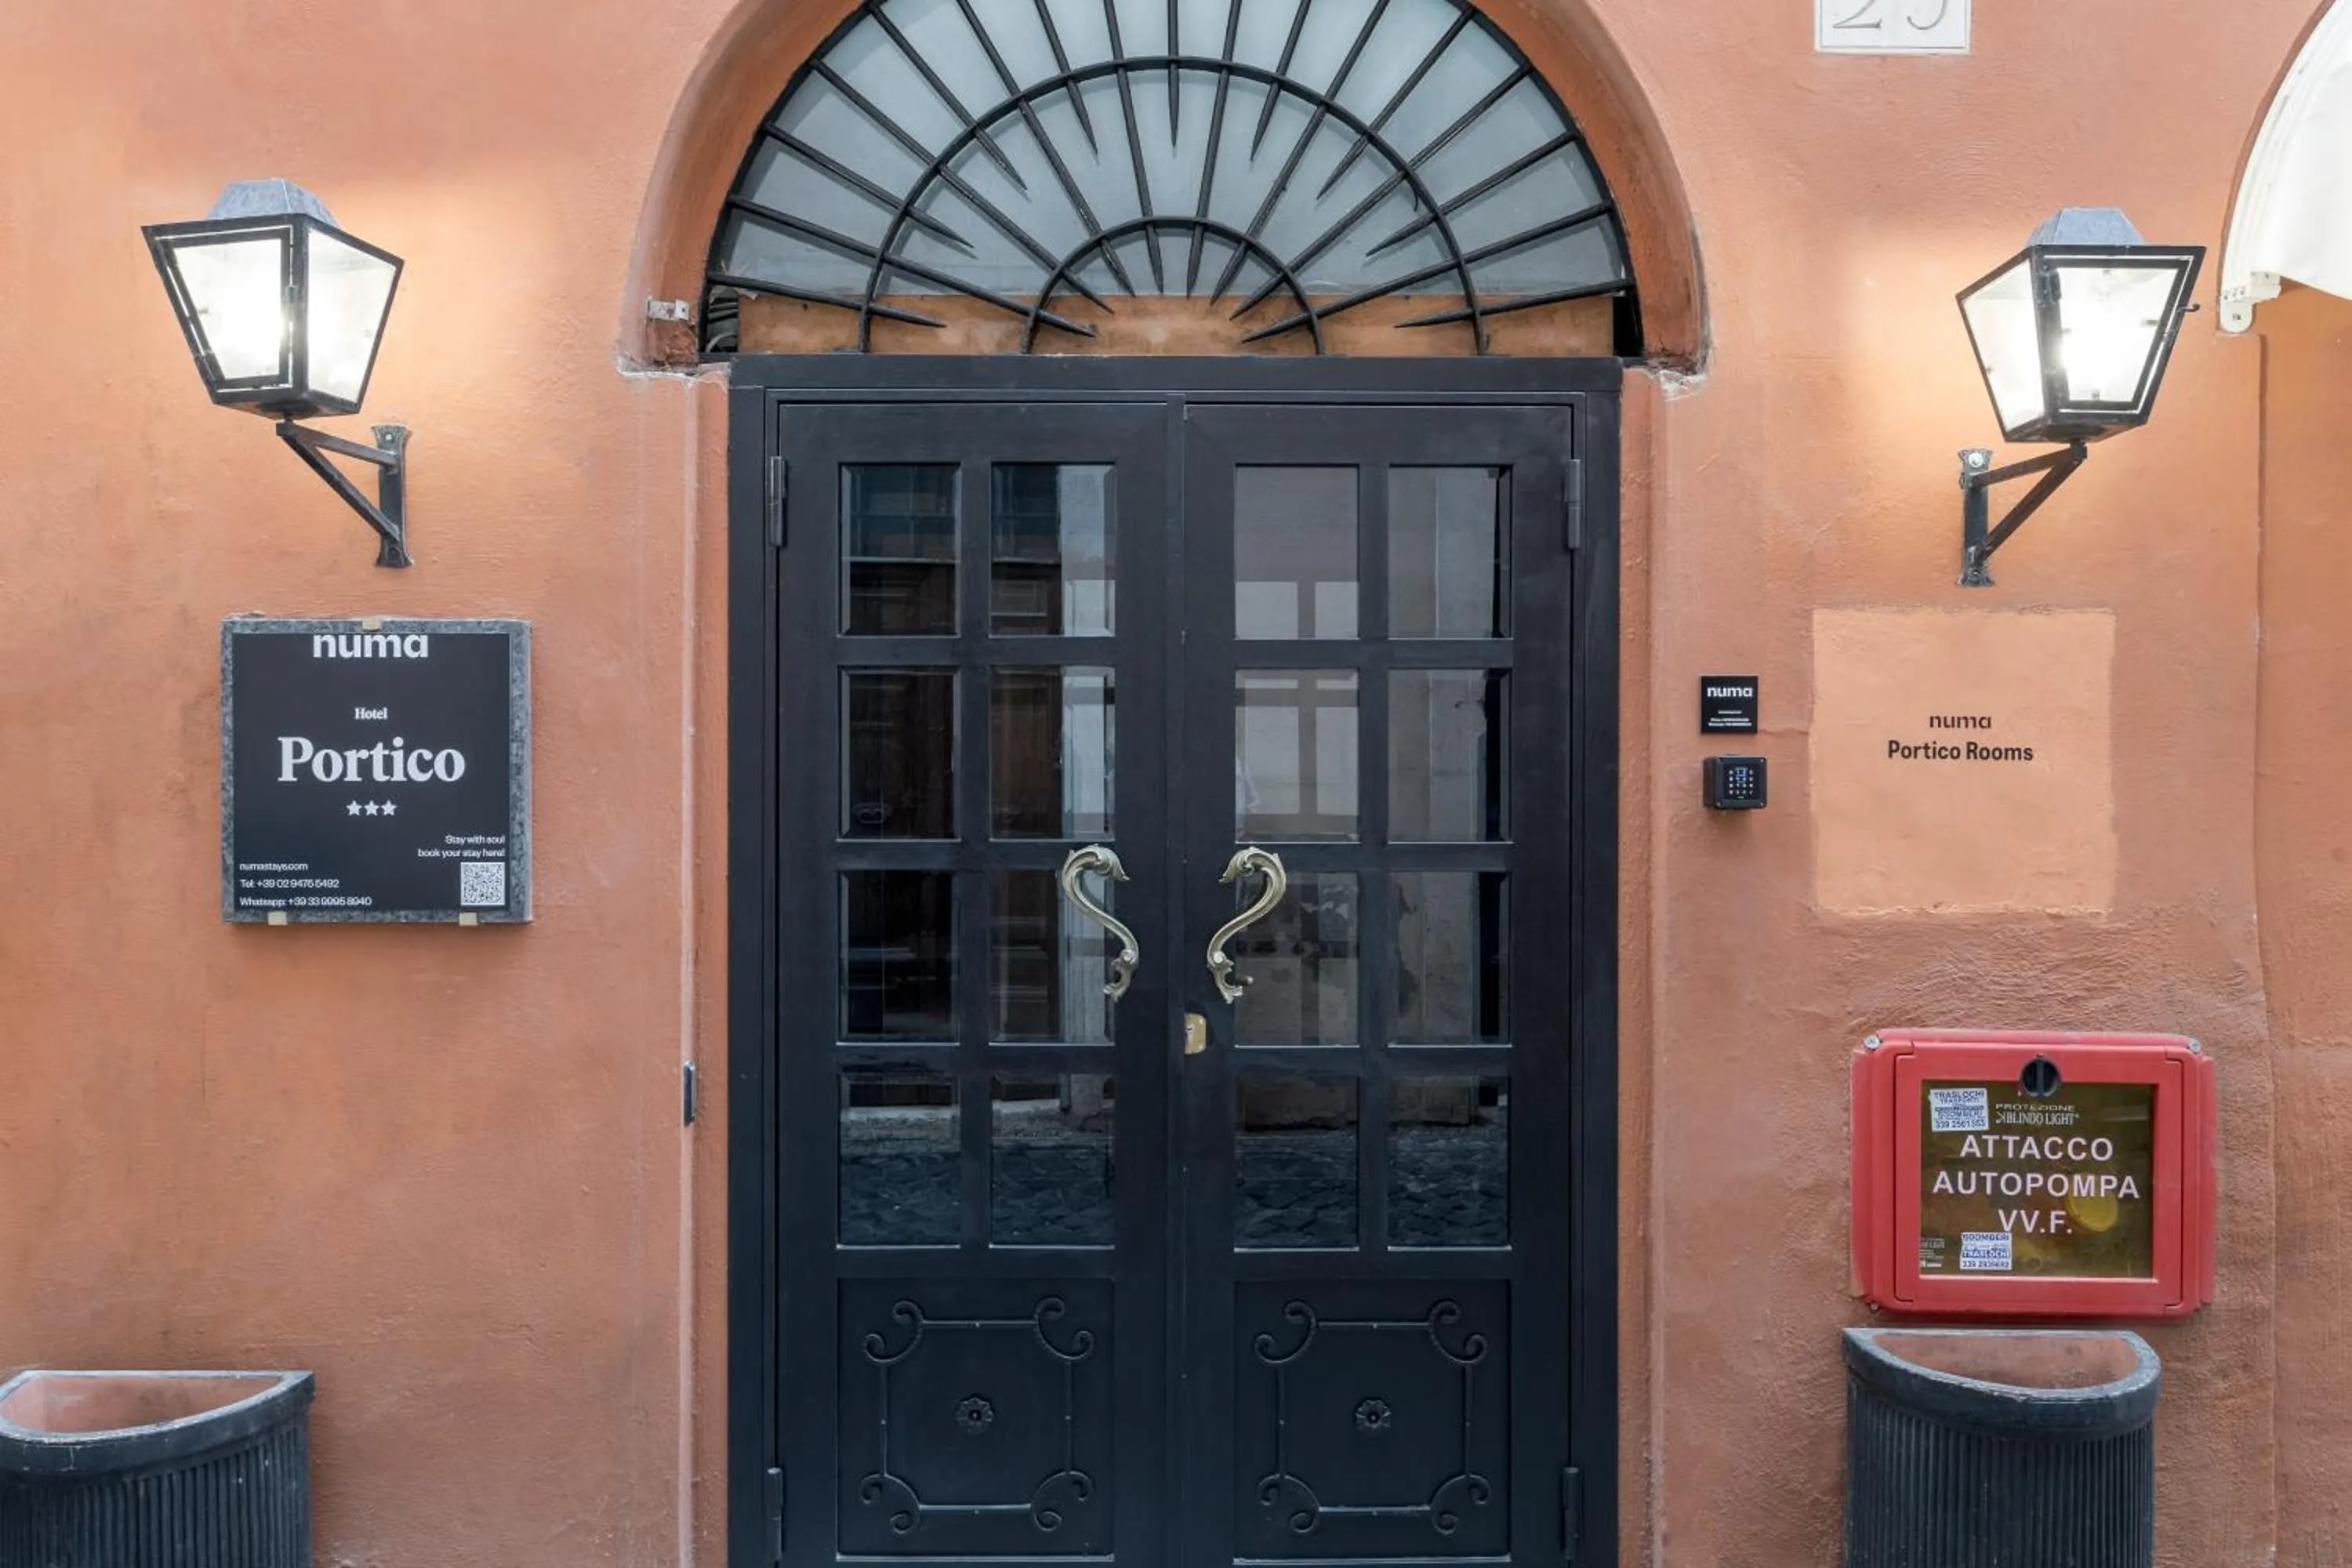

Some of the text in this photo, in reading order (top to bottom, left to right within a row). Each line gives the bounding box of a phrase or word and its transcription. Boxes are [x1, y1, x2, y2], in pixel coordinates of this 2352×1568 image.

[313, 633, 429, 659] numa
[1707, 687, 1753, 697] numa
[354, 707, 388, 720] Hotel
[1929, 714, 1992, 730] numa
[1888, 739, 2034, 762] Portico Rooms
[277, 736, 466, 782] Portico
[445, 835, 505, 846] Stay with soul
[418, 848, 441, 857] book
[239, 863, 308, 872] numastays.com
[1995, 1103, 2076, 1112] PROTEZIONE
[1960, 1134, 2114, 1162] ATTACCO
[1932, 1171, 2140, 1199] AUTOPOMPA
[1998, 1209, 2073, 1234] VV.F.
